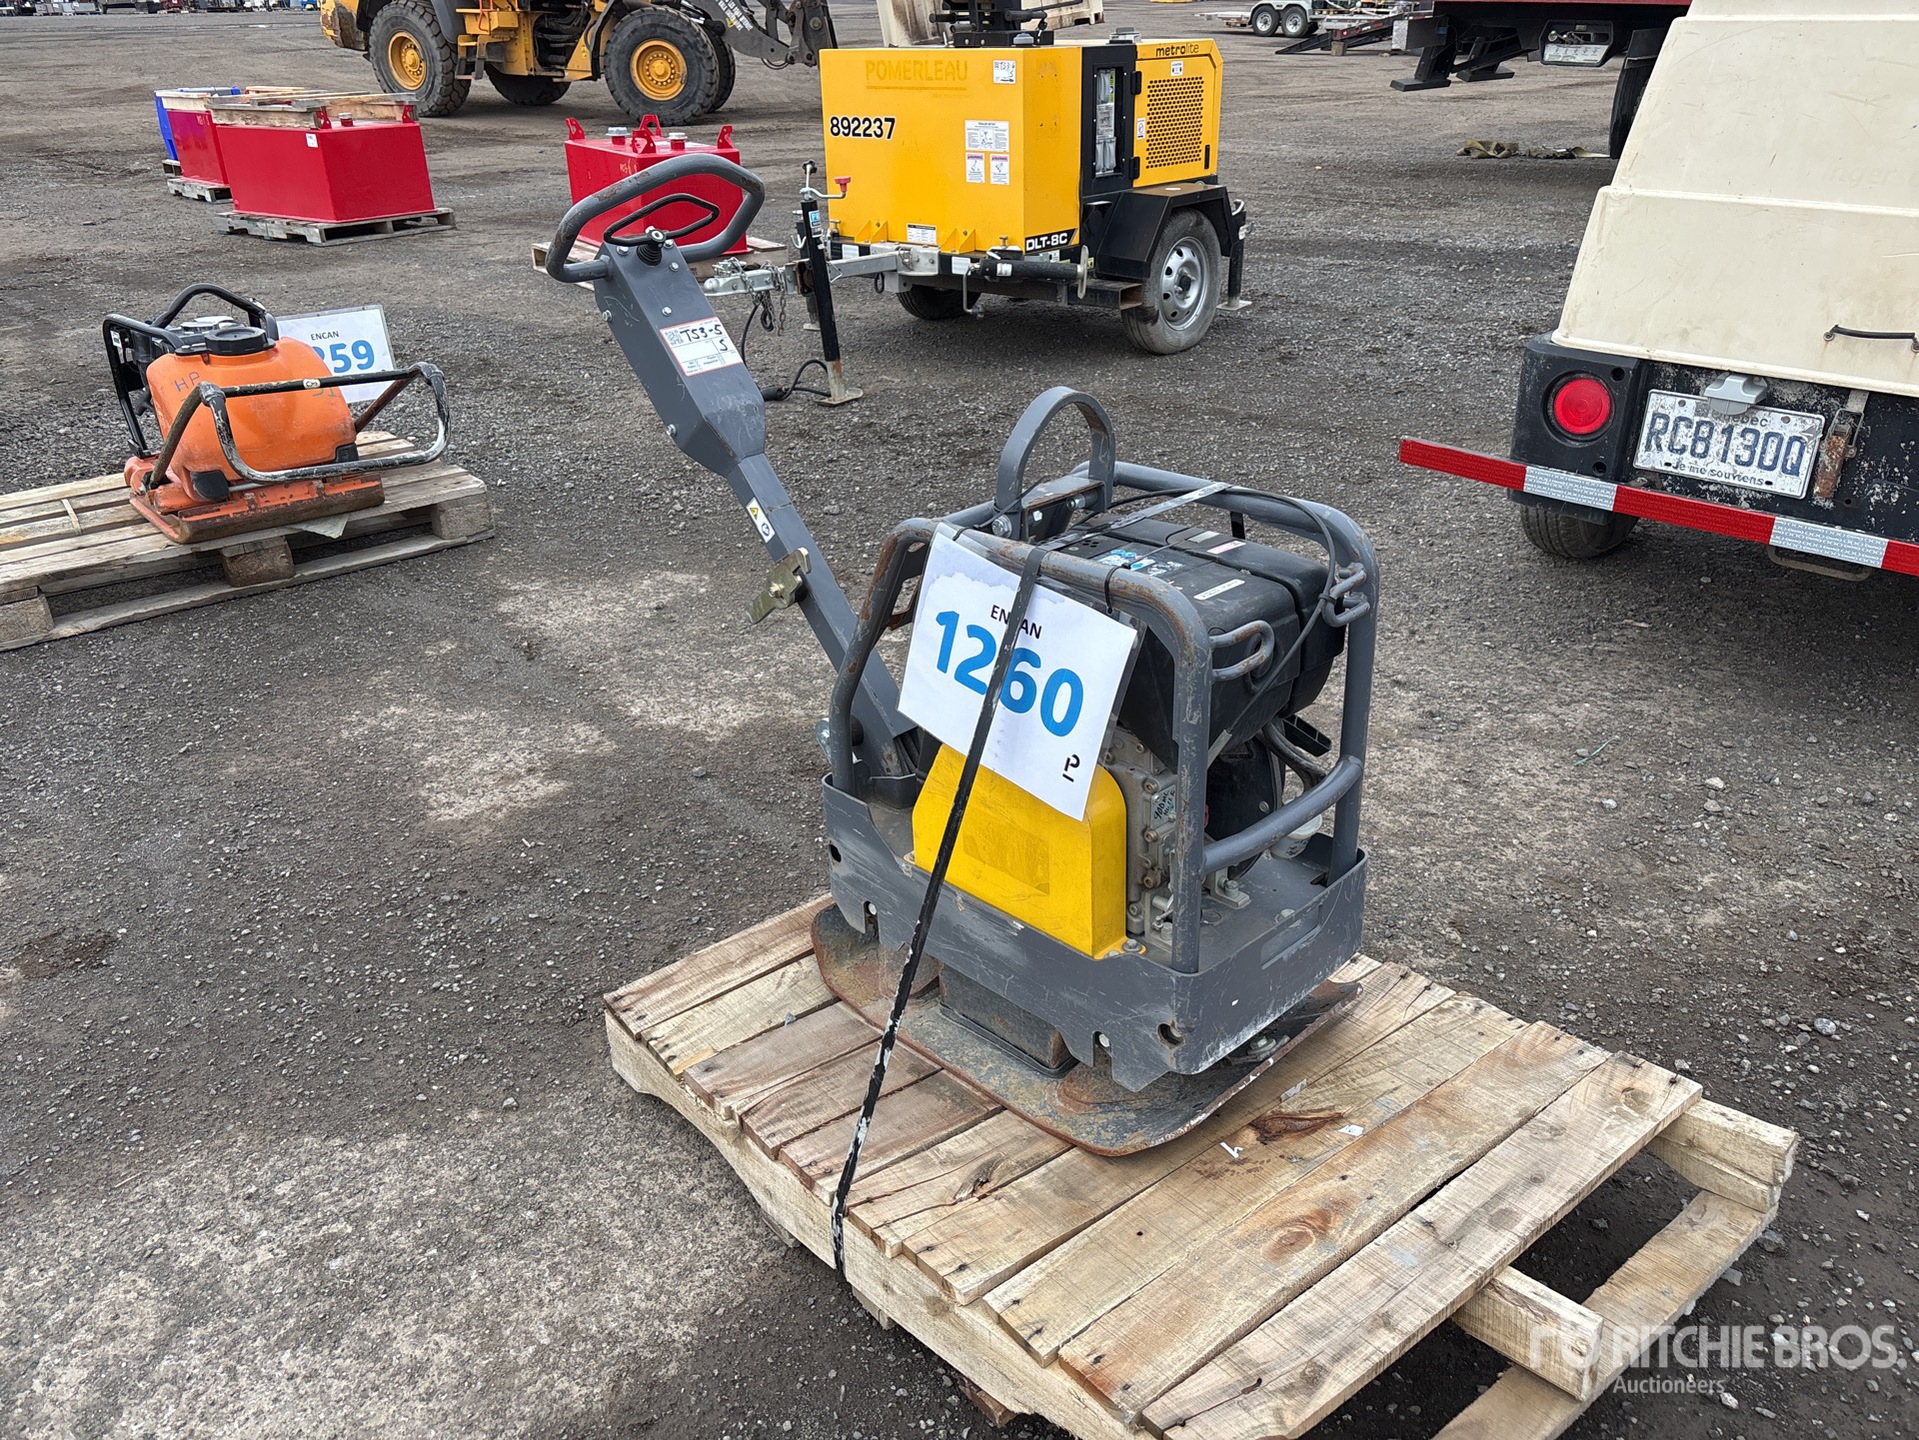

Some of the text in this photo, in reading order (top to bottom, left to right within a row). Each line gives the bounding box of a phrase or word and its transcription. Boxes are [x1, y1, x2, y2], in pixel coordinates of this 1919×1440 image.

[1155, 43, 1200, 57] metrolite
[865, 59, 968, 82] POMERLEAU
[829, 116, 896, 140] 892237
[1025, 232, 1068, 252] DLT-8C
[310, 330, 340, 341] ENCAN
[1672, 461, 1764, 486] Je me souviens
[990, 604, 1042, 640] ENAN
[935, 610, 1085, 738] 1260
